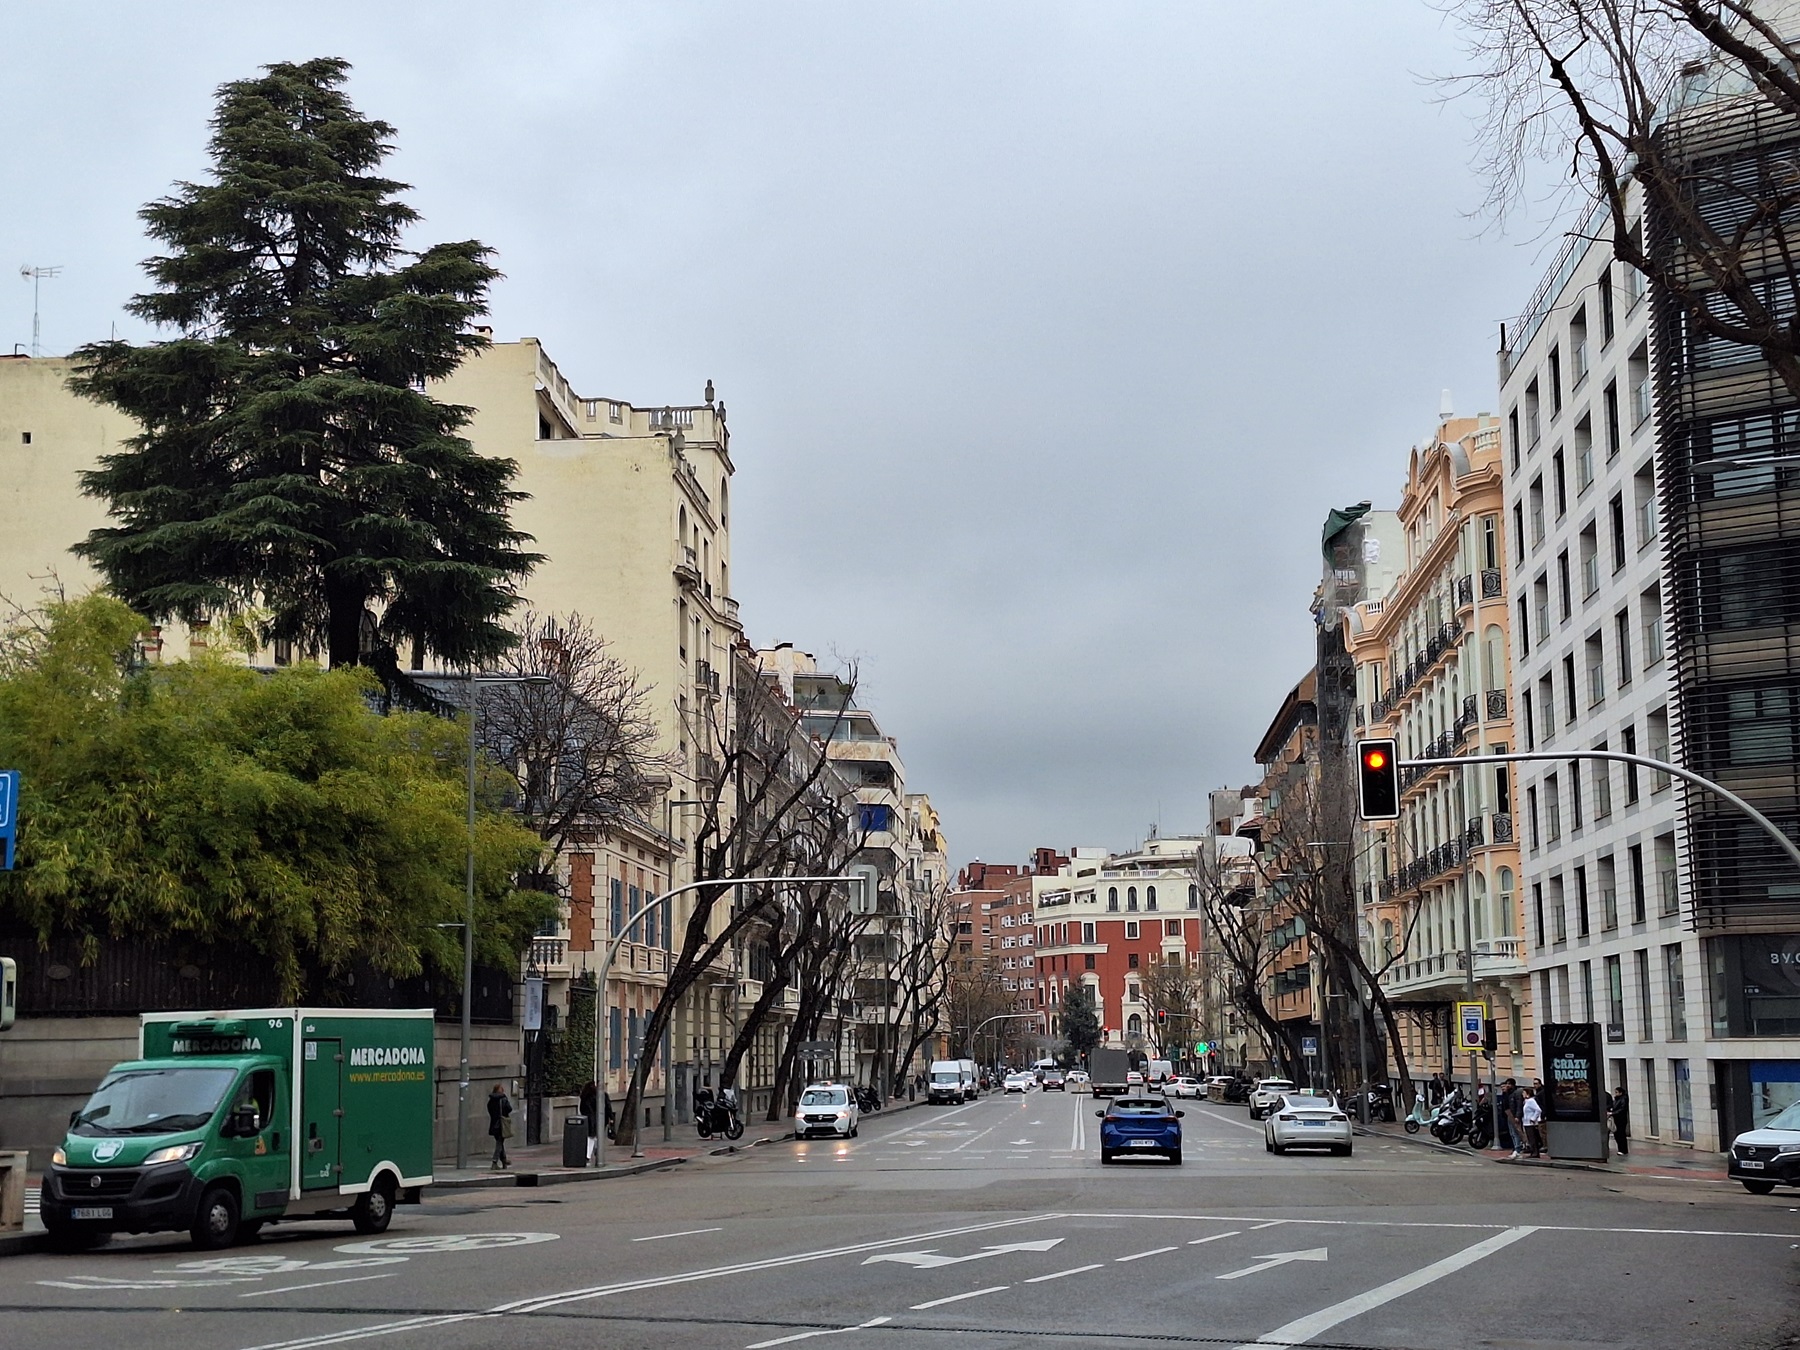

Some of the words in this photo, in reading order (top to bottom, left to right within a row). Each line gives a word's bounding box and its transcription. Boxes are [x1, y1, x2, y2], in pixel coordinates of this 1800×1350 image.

[268, 1019, 283, 1029] 96
[172, 1037, 262, 1053] MERCADONA
[350, 1047, 426, 1066] MERCADONA
[1553, 1059, 1587, 1069] CRAZY
[349, 1068, 426, 1082] www.mercadona.es
[1554, 1069, 1588, 1081] BACON
